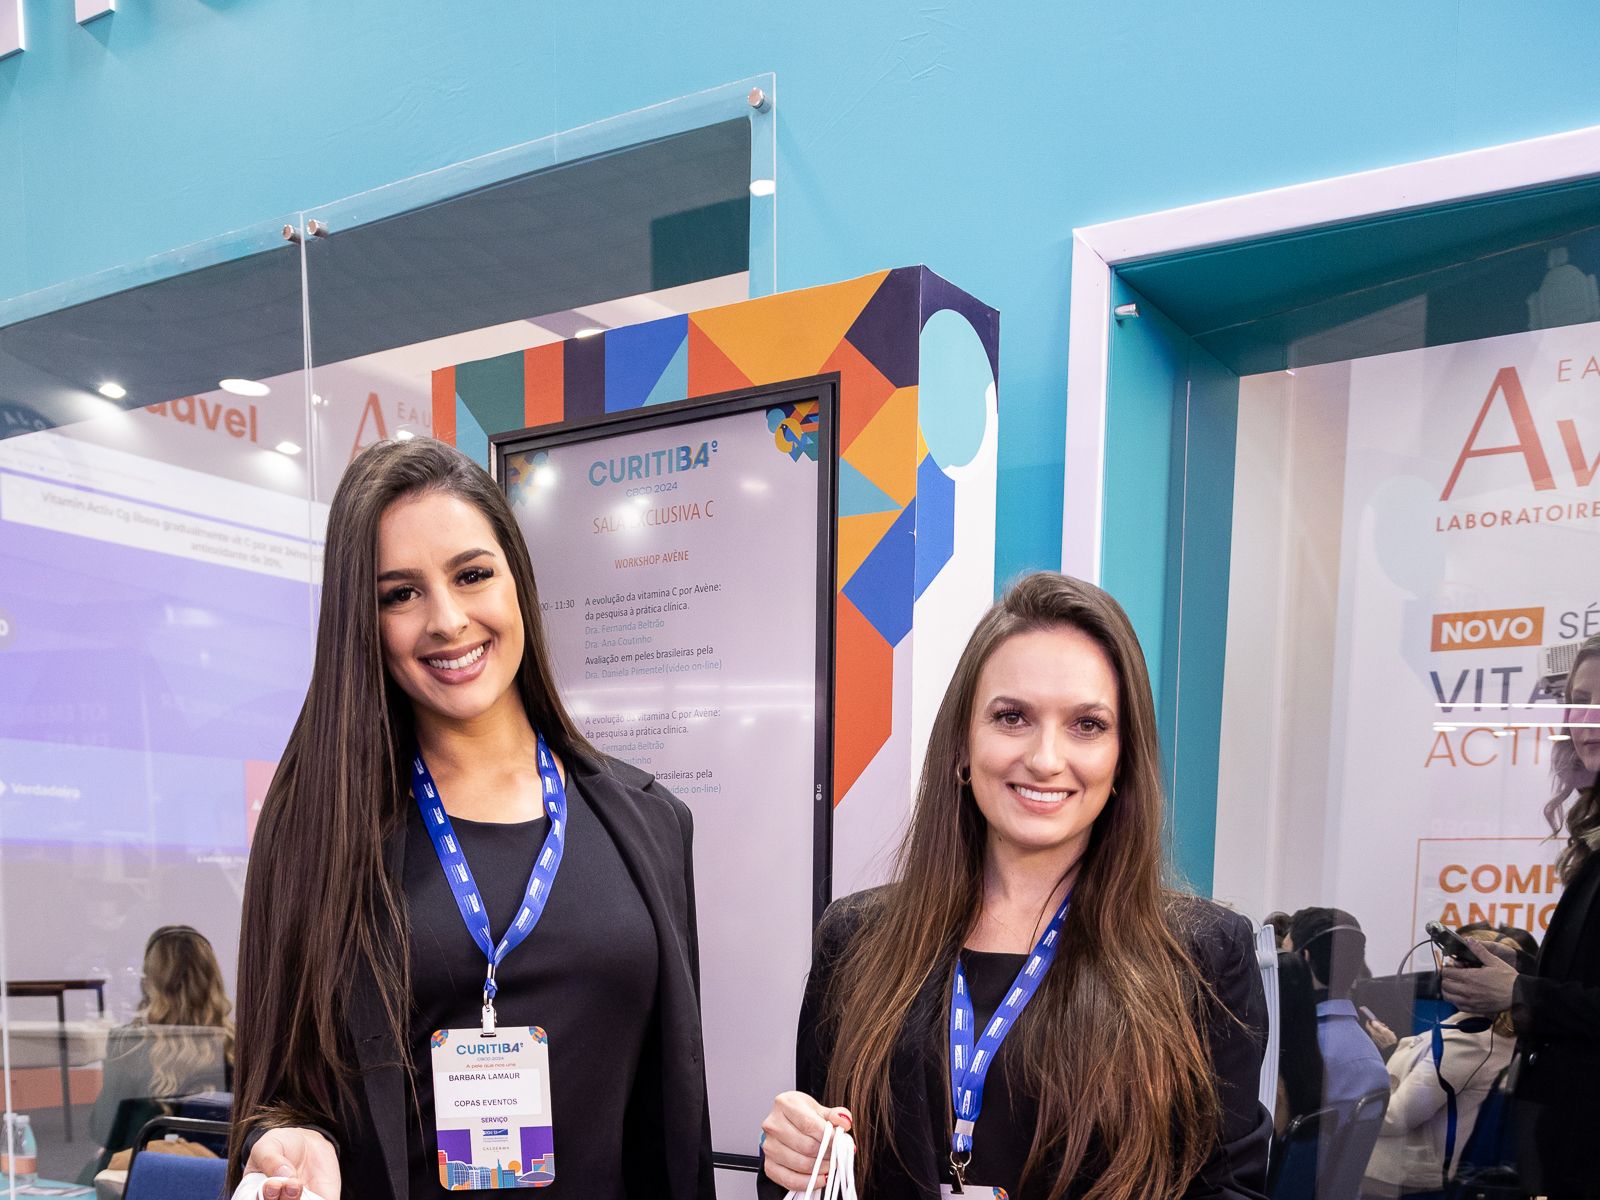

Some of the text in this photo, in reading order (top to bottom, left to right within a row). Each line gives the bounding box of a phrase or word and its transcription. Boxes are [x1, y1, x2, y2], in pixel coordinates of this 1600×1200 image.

[654, 481, 678, 493] 2024
[705, 500, 714, 518] C
[614, 554, 661, 569] WORKSHOP
[585, 597, 591, 607] A
[592, 593, 625, 607] evolução
[626, 591, 636, 601] da
[637, 588, 670, 601] vitamina
[671, 587, 678, 597] C
[678, 587, 692, 599] por
[555, 599, 575, 610] 11:30
[585, 611, 595, 621] da
[595, 607, 628, 622] pesquisa
[636, 604, 662, 618] prática
[601, 622, 637, 635] Fernanda
[638, 618, 665, 631] Beltrão
[1441, 616, 1534, 644] NOVO
[602, 637, 616, 648] Ana
[618, 635, 652, 647] Coutinho
[585, 644, 713, 667] Avaliação em peles brasileiras pela
[601, 667, 629, 679] Daniela
[631, 664, 665, 677] Pimentel
[592, 713, 625, 725] evolução
[638, 711, 670, 723] vitamina
[671, 710, 678, 720] C
[678, 710, 692, 721] por
[585, 730, 595, 739] da
[595, 727, 628, 740] pesquisa
[635, 726, 662, 738] prática
[1424, 727, 1558, 768] ACTI
[655, 769, 713, 780] brasileiras pela
[488, 1072, 520, 1080] LAMAUR
[454, 1098, 518, 1107] COPAS EVENTOS
